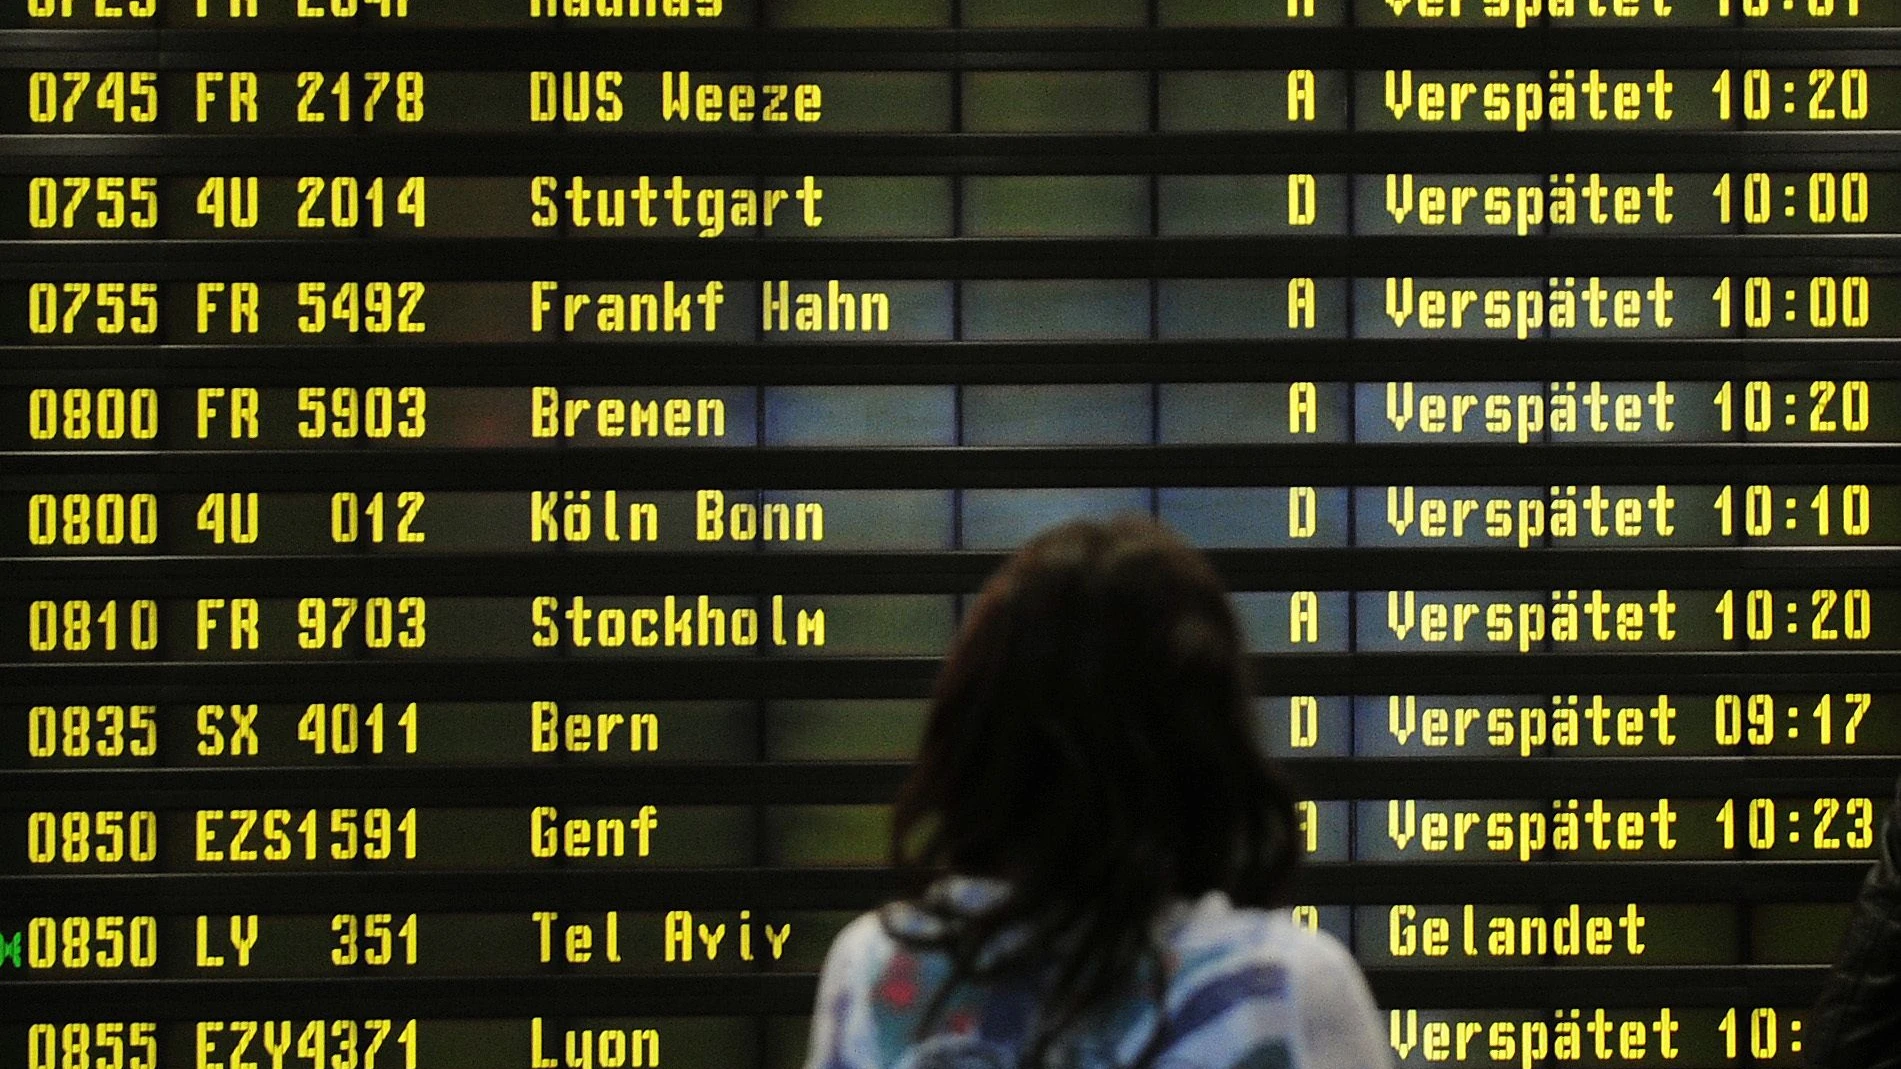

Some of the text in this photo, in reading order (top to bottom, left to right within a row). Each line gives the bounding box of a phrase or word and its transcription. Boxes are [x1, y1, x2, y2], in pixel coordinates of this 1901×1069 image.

[29, 68, 1868, 132] 0745 FR 2178 DUS Weeze A Verspätet 10:20
[29, 172, 1869, 238] 0755 4U 2014 Stuttgart D Verspätet 10:00
[29, 276, 1869, 340] 0755 FR 5492 Frankf Hahn A Verspätet 10:00
[29, 380, 1869, 444] 0800 FR 5903 Bremen A Verspätet 10:20
[29, 484, 1870, 549] 0800 4U 012 Köln Bonn D Verspätet 10:10
[29, 589, 1871, 653] 0810 FR 9703 Stockholm A Verspätet 10:20
[29, 693, 1871, 757] 0835 SX 4011 Bern D Verspätet 09:17
[28, 811, 157, 863] 0850
[196, 807, 417, 862] EZS1591
[531, 805, 658, 858] Genf
[1388, 798, 1677, 862] Verspätet
[1715, 797, 1873, 850] 10:23
[28, 903, 1646, 969] 0850 LY 351 Tel Aviv Gelandet
[28, 1007, 1802, 1069] 0855 EZY4371 Lyon Verspätet 10:
